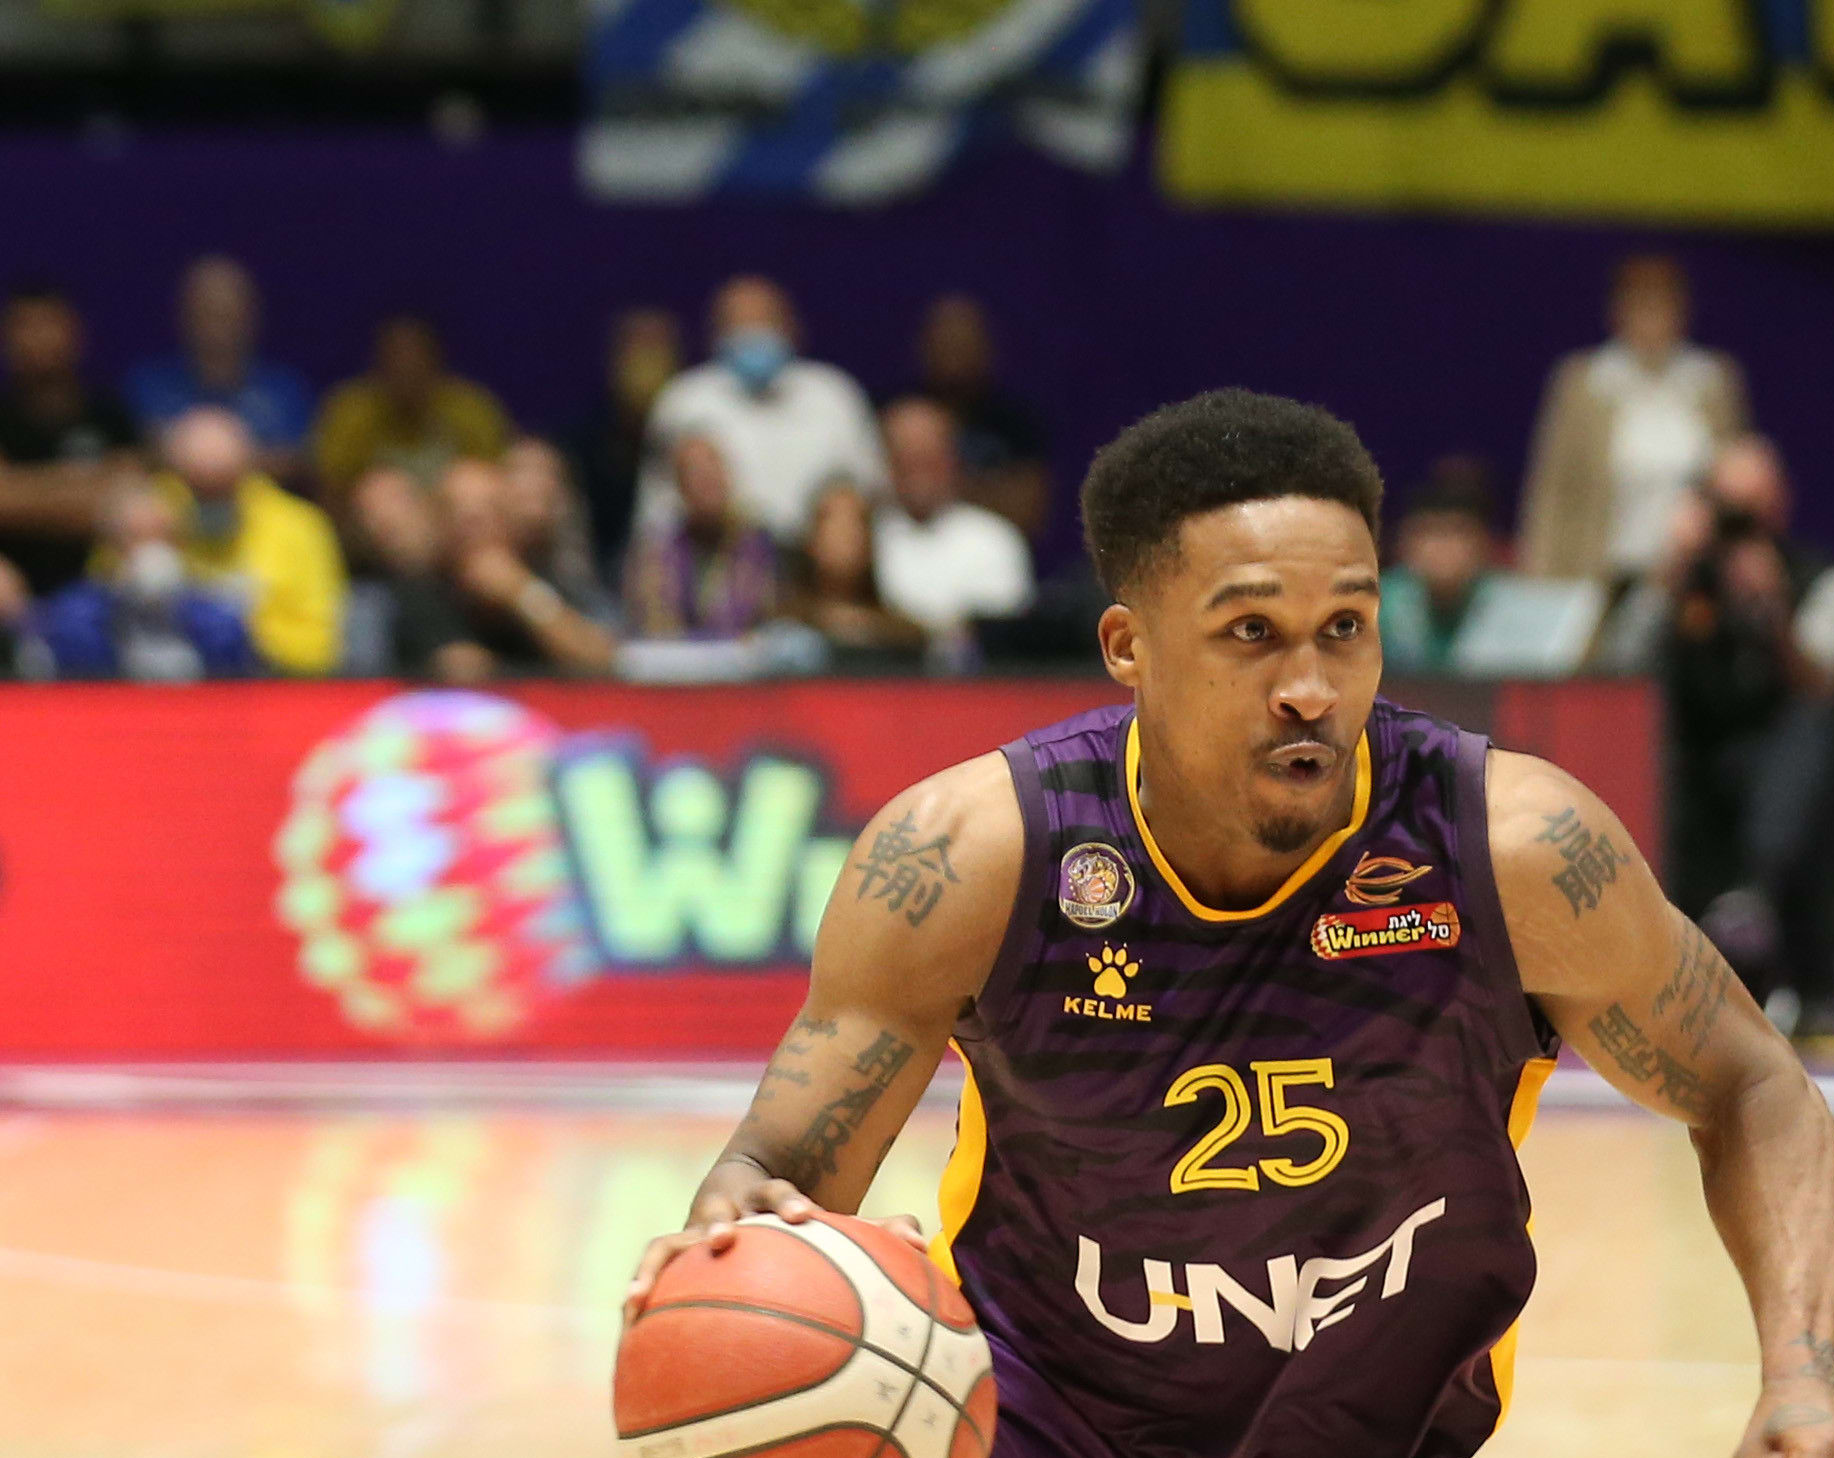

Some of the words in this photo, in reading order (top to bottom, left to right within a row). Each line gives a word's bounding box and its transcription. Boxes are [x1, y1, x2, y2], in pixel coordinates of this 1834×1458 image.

[1388, 909, 1421, 929] ליגת
[1327, 925, 1425, 950] Winner
[1427, 920, 1450, 939] סל
[1064, 996, 1152, 1021] KELME
[1163, 1057, 1350, 1194] 25
